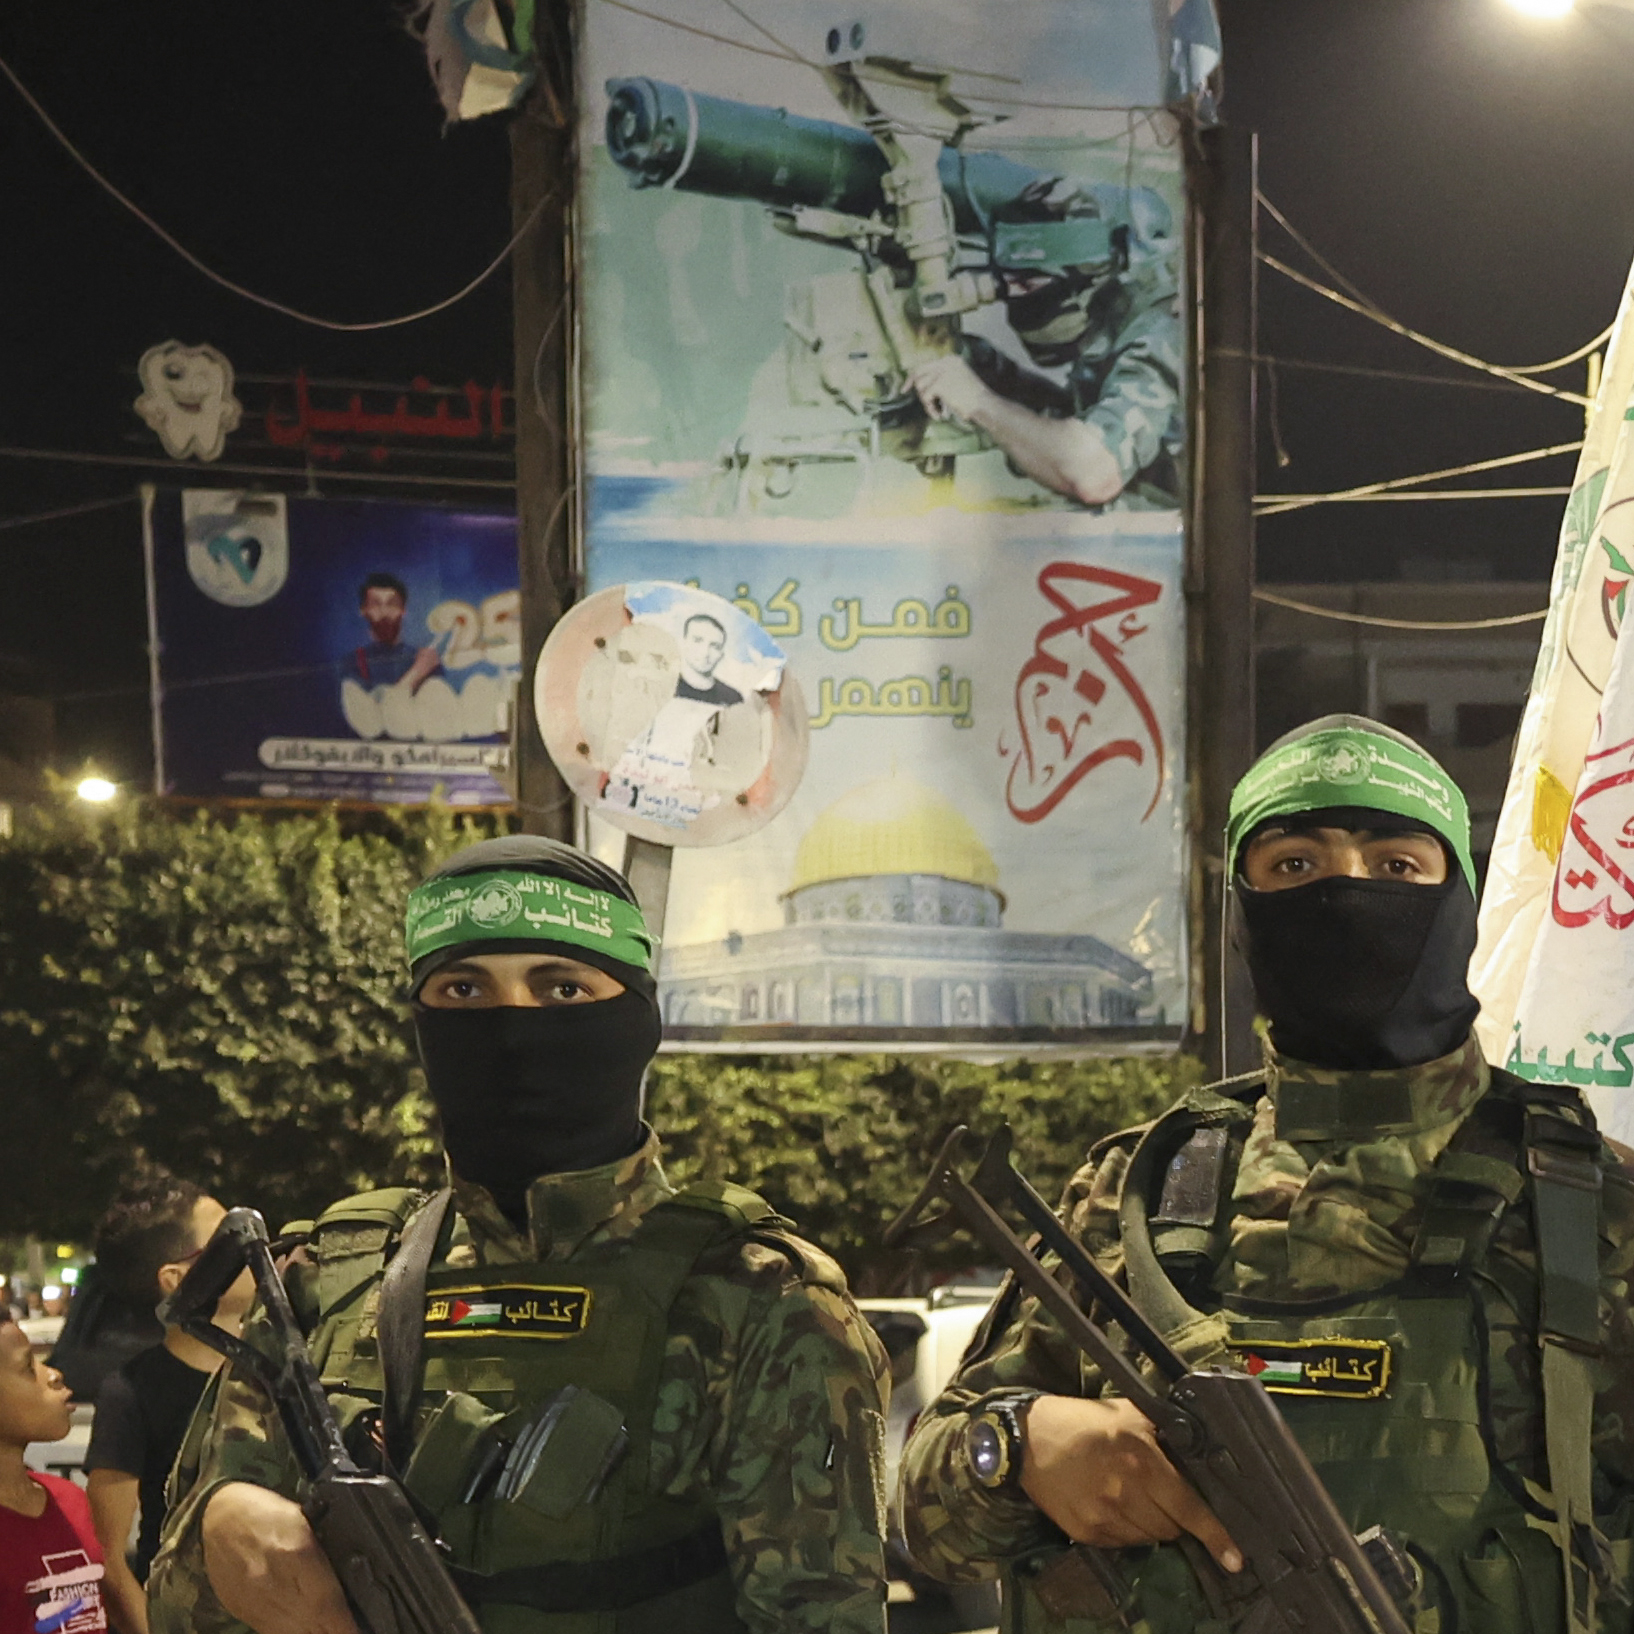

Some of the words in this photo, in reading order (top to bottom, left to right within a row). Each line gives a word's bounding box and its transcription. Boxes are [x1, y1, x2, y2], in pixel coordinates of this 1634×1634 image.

[818, 584, 973, 651] فمن
[524, 903, 613, 939] كتائب
[505, 1299, 577, 1324] كتائب
[1305, 1357, 1377, 1382] كتائب
